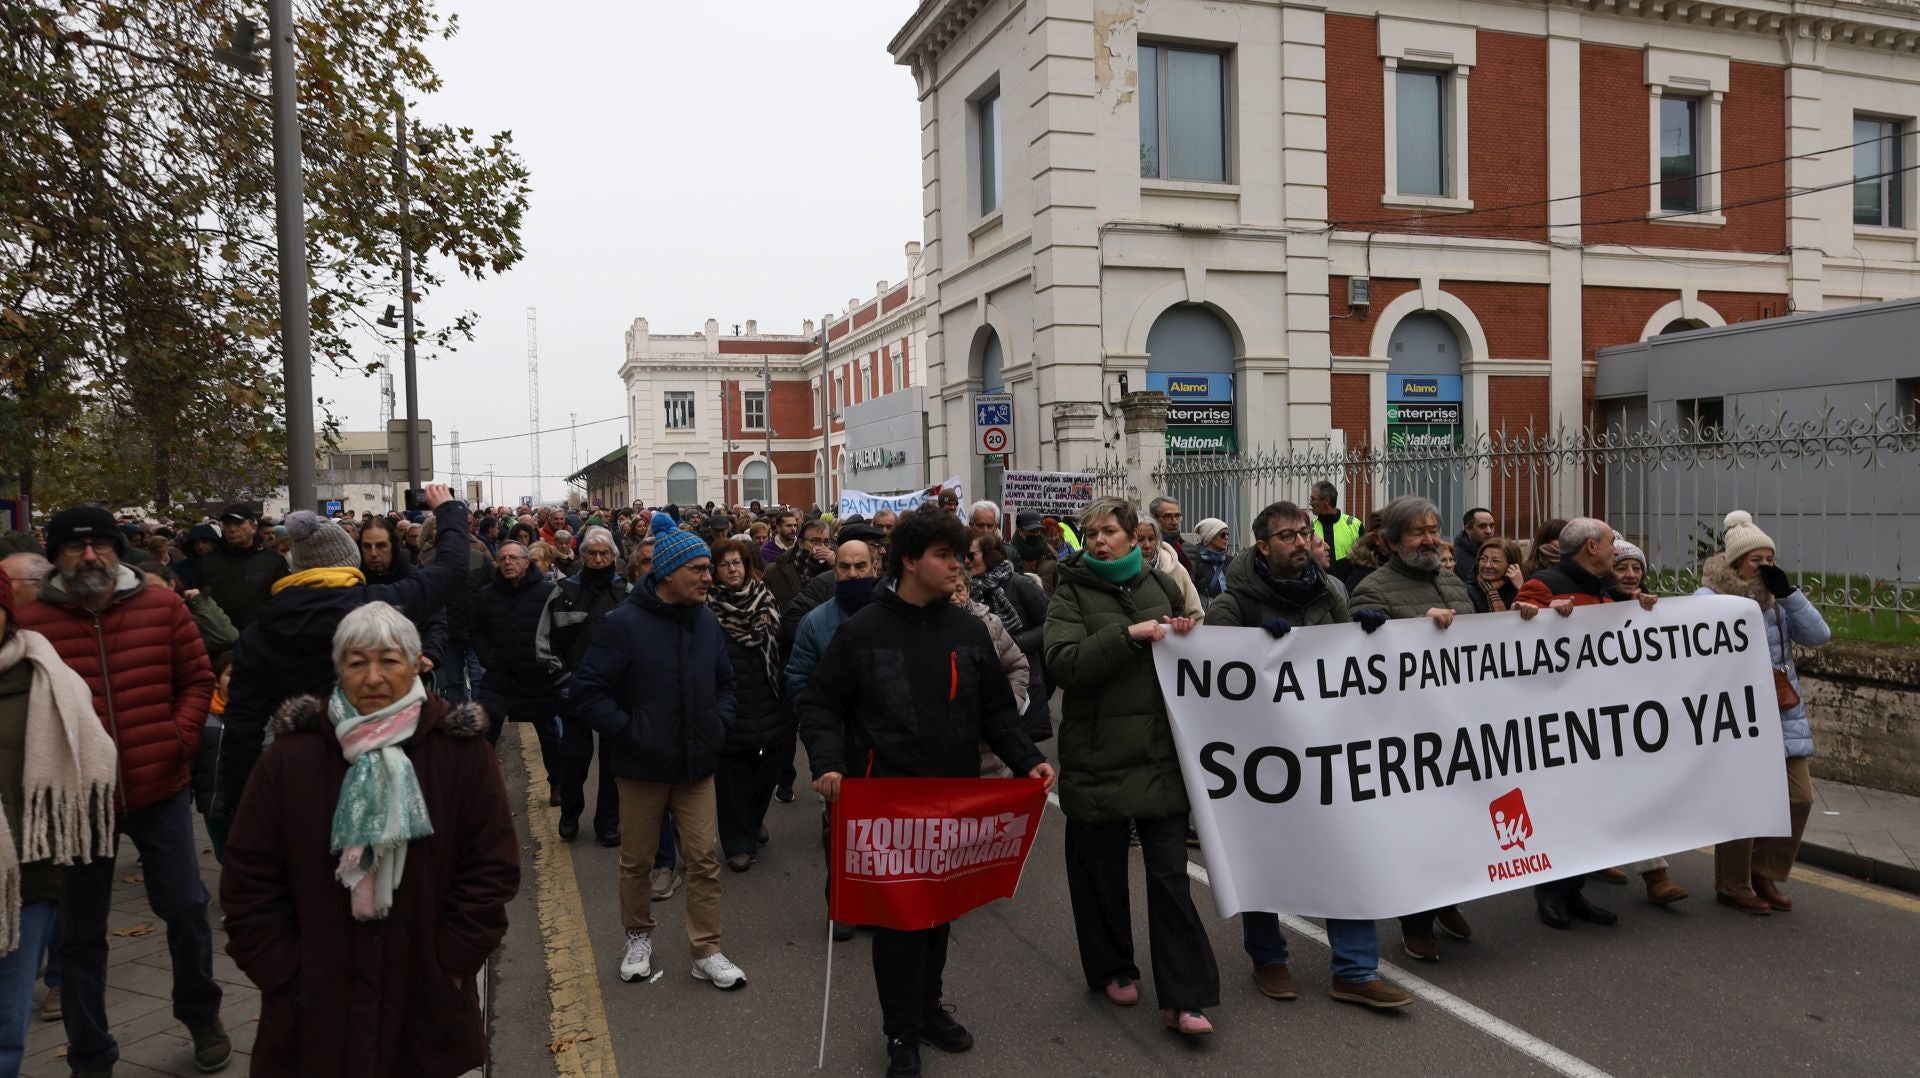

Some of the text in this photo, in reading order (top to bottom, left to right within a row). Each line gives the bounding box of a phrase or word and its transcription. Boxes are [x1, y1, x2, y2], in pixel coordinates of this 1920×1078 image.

[1170, 382, 1207, 392] Alamo
[1404, 384, 1436, 392] Alamo
[1166, 408, 1230, 422] nterprise
[1387, 408, 1457, 421] enterprise
[988, 435, 1002, 444] 20
[1170, 435, 1224, 449] National
[855, 447, 882, 469] PALENCIA
[1014, 483, 1042, 491] PUENTES
[1176, 618, 1749, 702] NO A LAS PANTALLAS ACÚSTICAS
[1199, 684, 1760, 806] SOTERRAMIENTO YA!
[845, 816, 996, 854] IZQUIERDA
[845, 837, 1021, 877] REVOLUCIONARIA
[1487, 852, 1553, 883] PALENCIA
